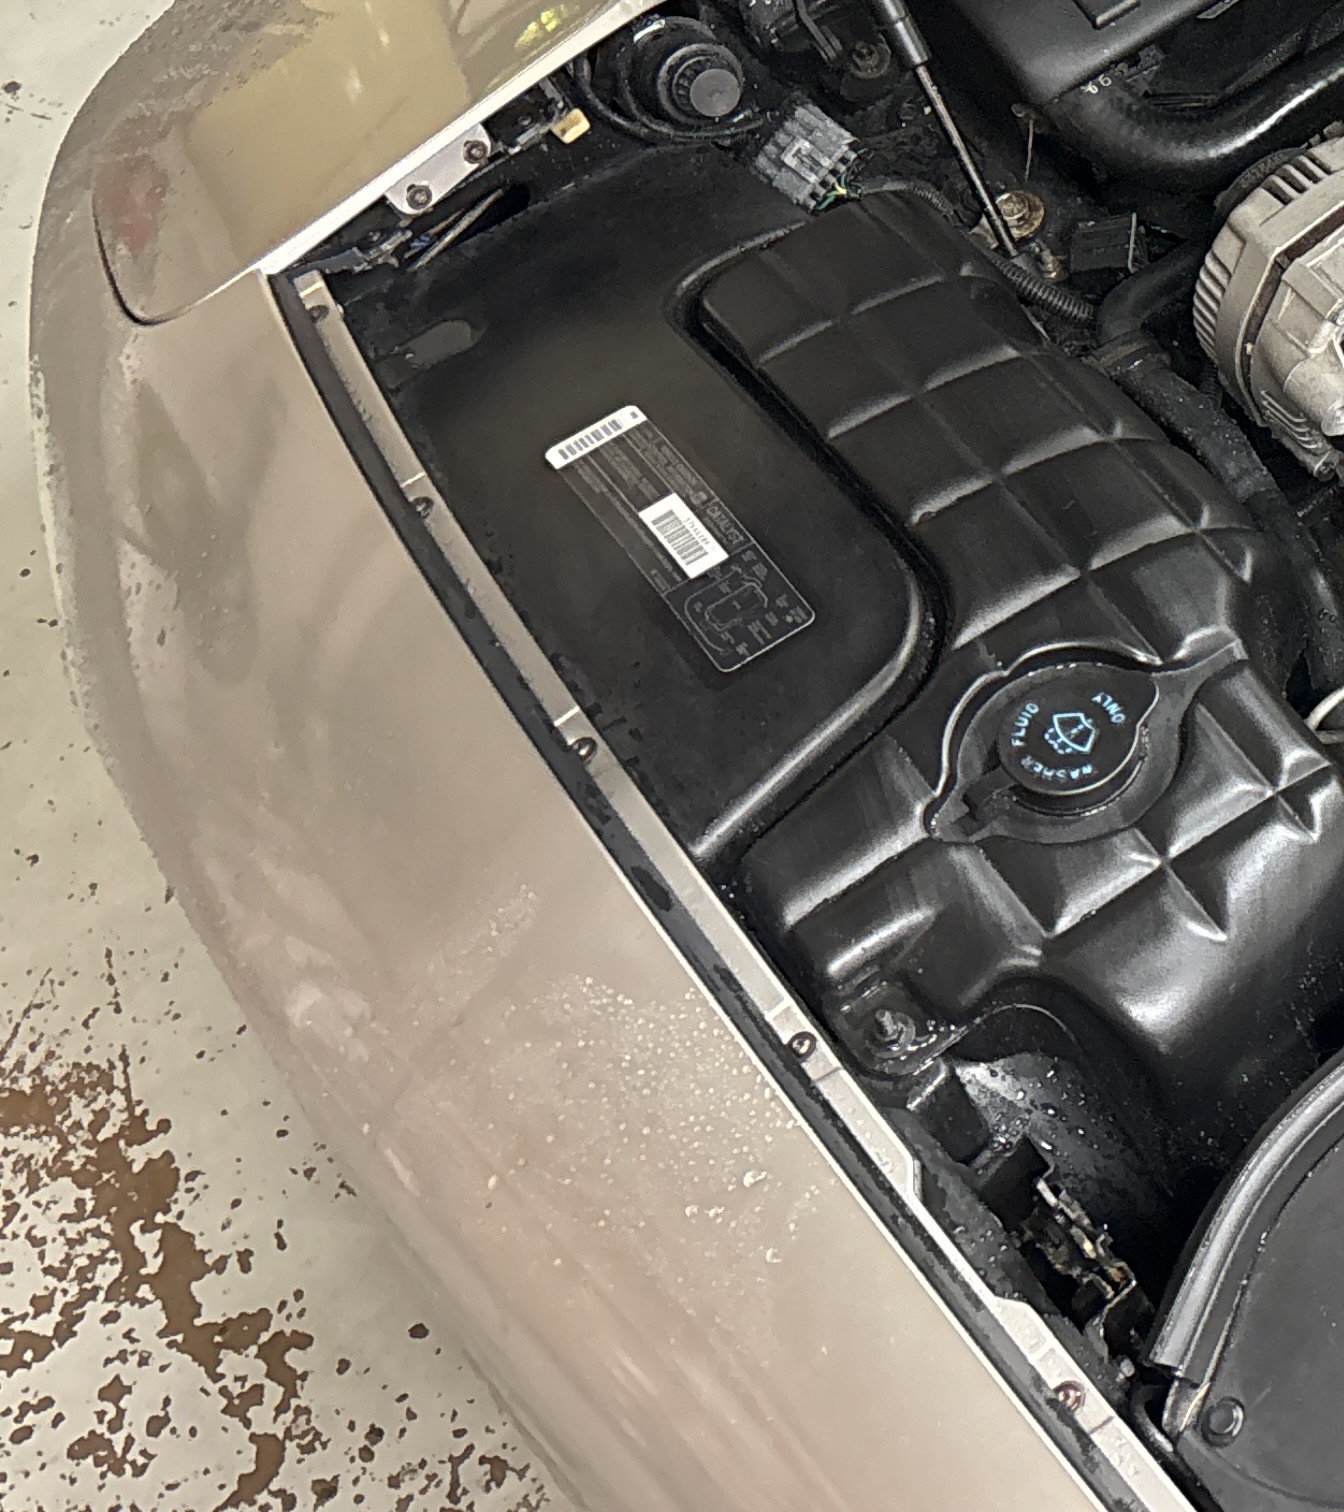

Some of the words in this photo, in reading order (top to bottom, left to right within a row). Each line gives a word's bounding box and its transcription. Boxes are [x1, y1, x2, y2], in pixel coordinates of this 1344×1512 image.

[1011, 701, 1040, 748] FLUID
[1090, 692, 1127, 725] ONLY
[1019, 754, 1094, 781] WASHER
